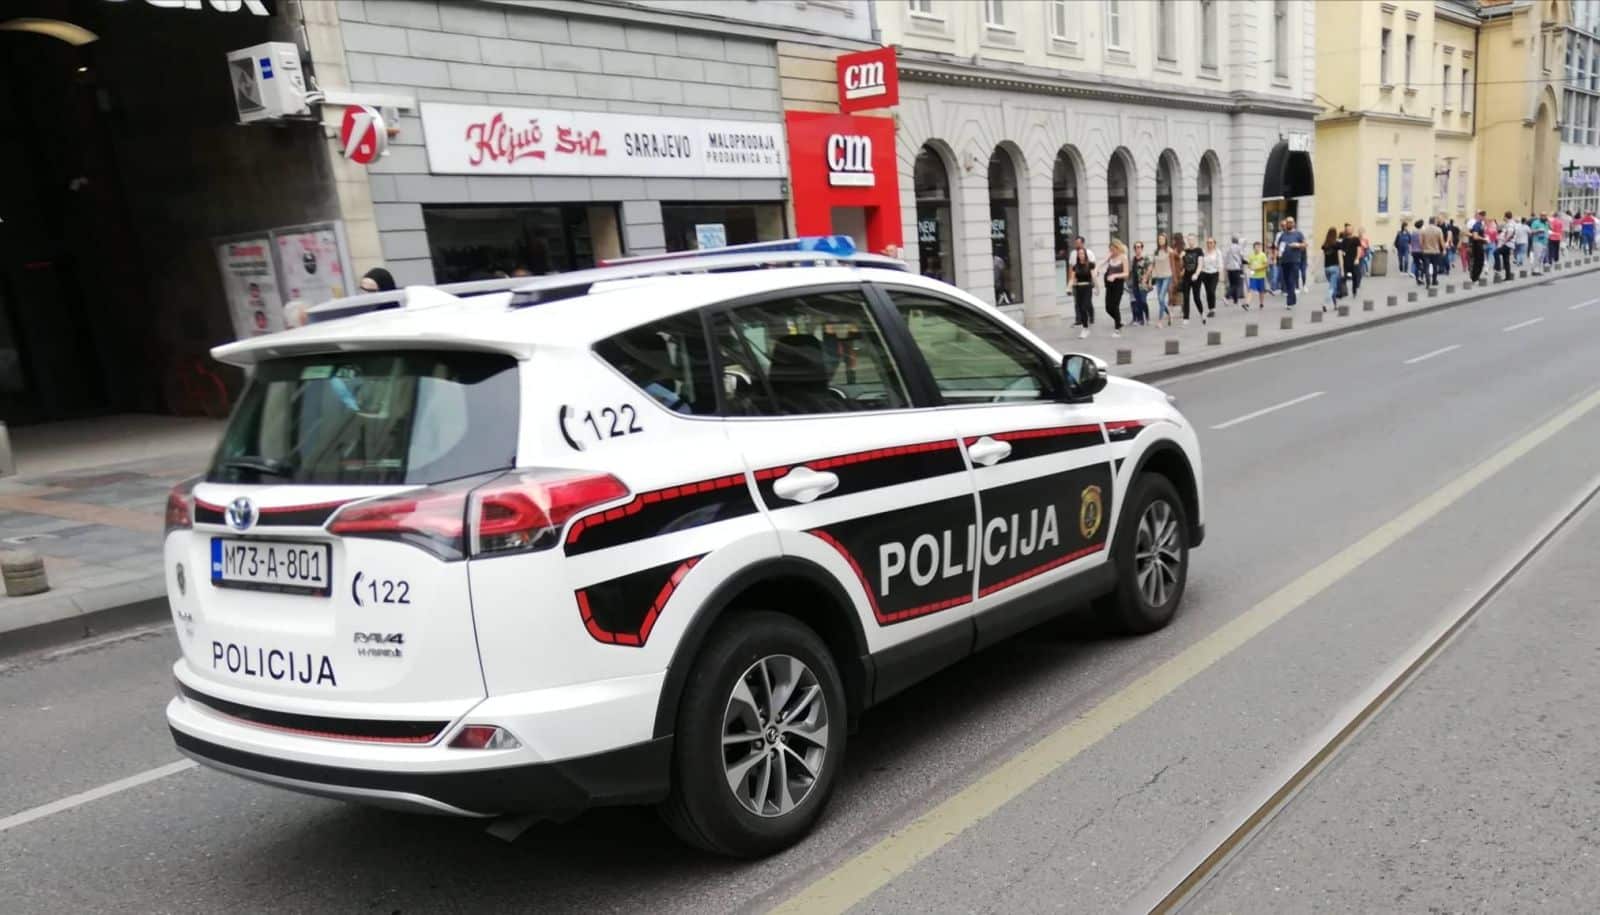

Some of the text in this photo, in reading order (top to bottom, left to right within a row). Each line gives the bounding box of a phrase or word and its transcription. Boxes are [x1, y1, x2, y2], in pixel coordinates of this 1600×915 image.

[844, 61, 885, 90] cm
[465, 112, 545, 166] Ključ
[624, 132, 691, 158] SARAJEVO
[708, 132, 776, 150] MALOPRODAJA
[827, 133, 873, 172] cm
[706, 151, 760, 164] PRODAVNICA
[919, 220, 936, 233] NEW
[584, 403, 643, 440] 122
[225, 544, 322, 582] M73-A-801
[879, 504, 1059, 597] POLICIJA
[368, 579, 410, 604] 122
[353, 631, 405, 645] RAV4
[212, 640, 337, 687] POLICIJA
